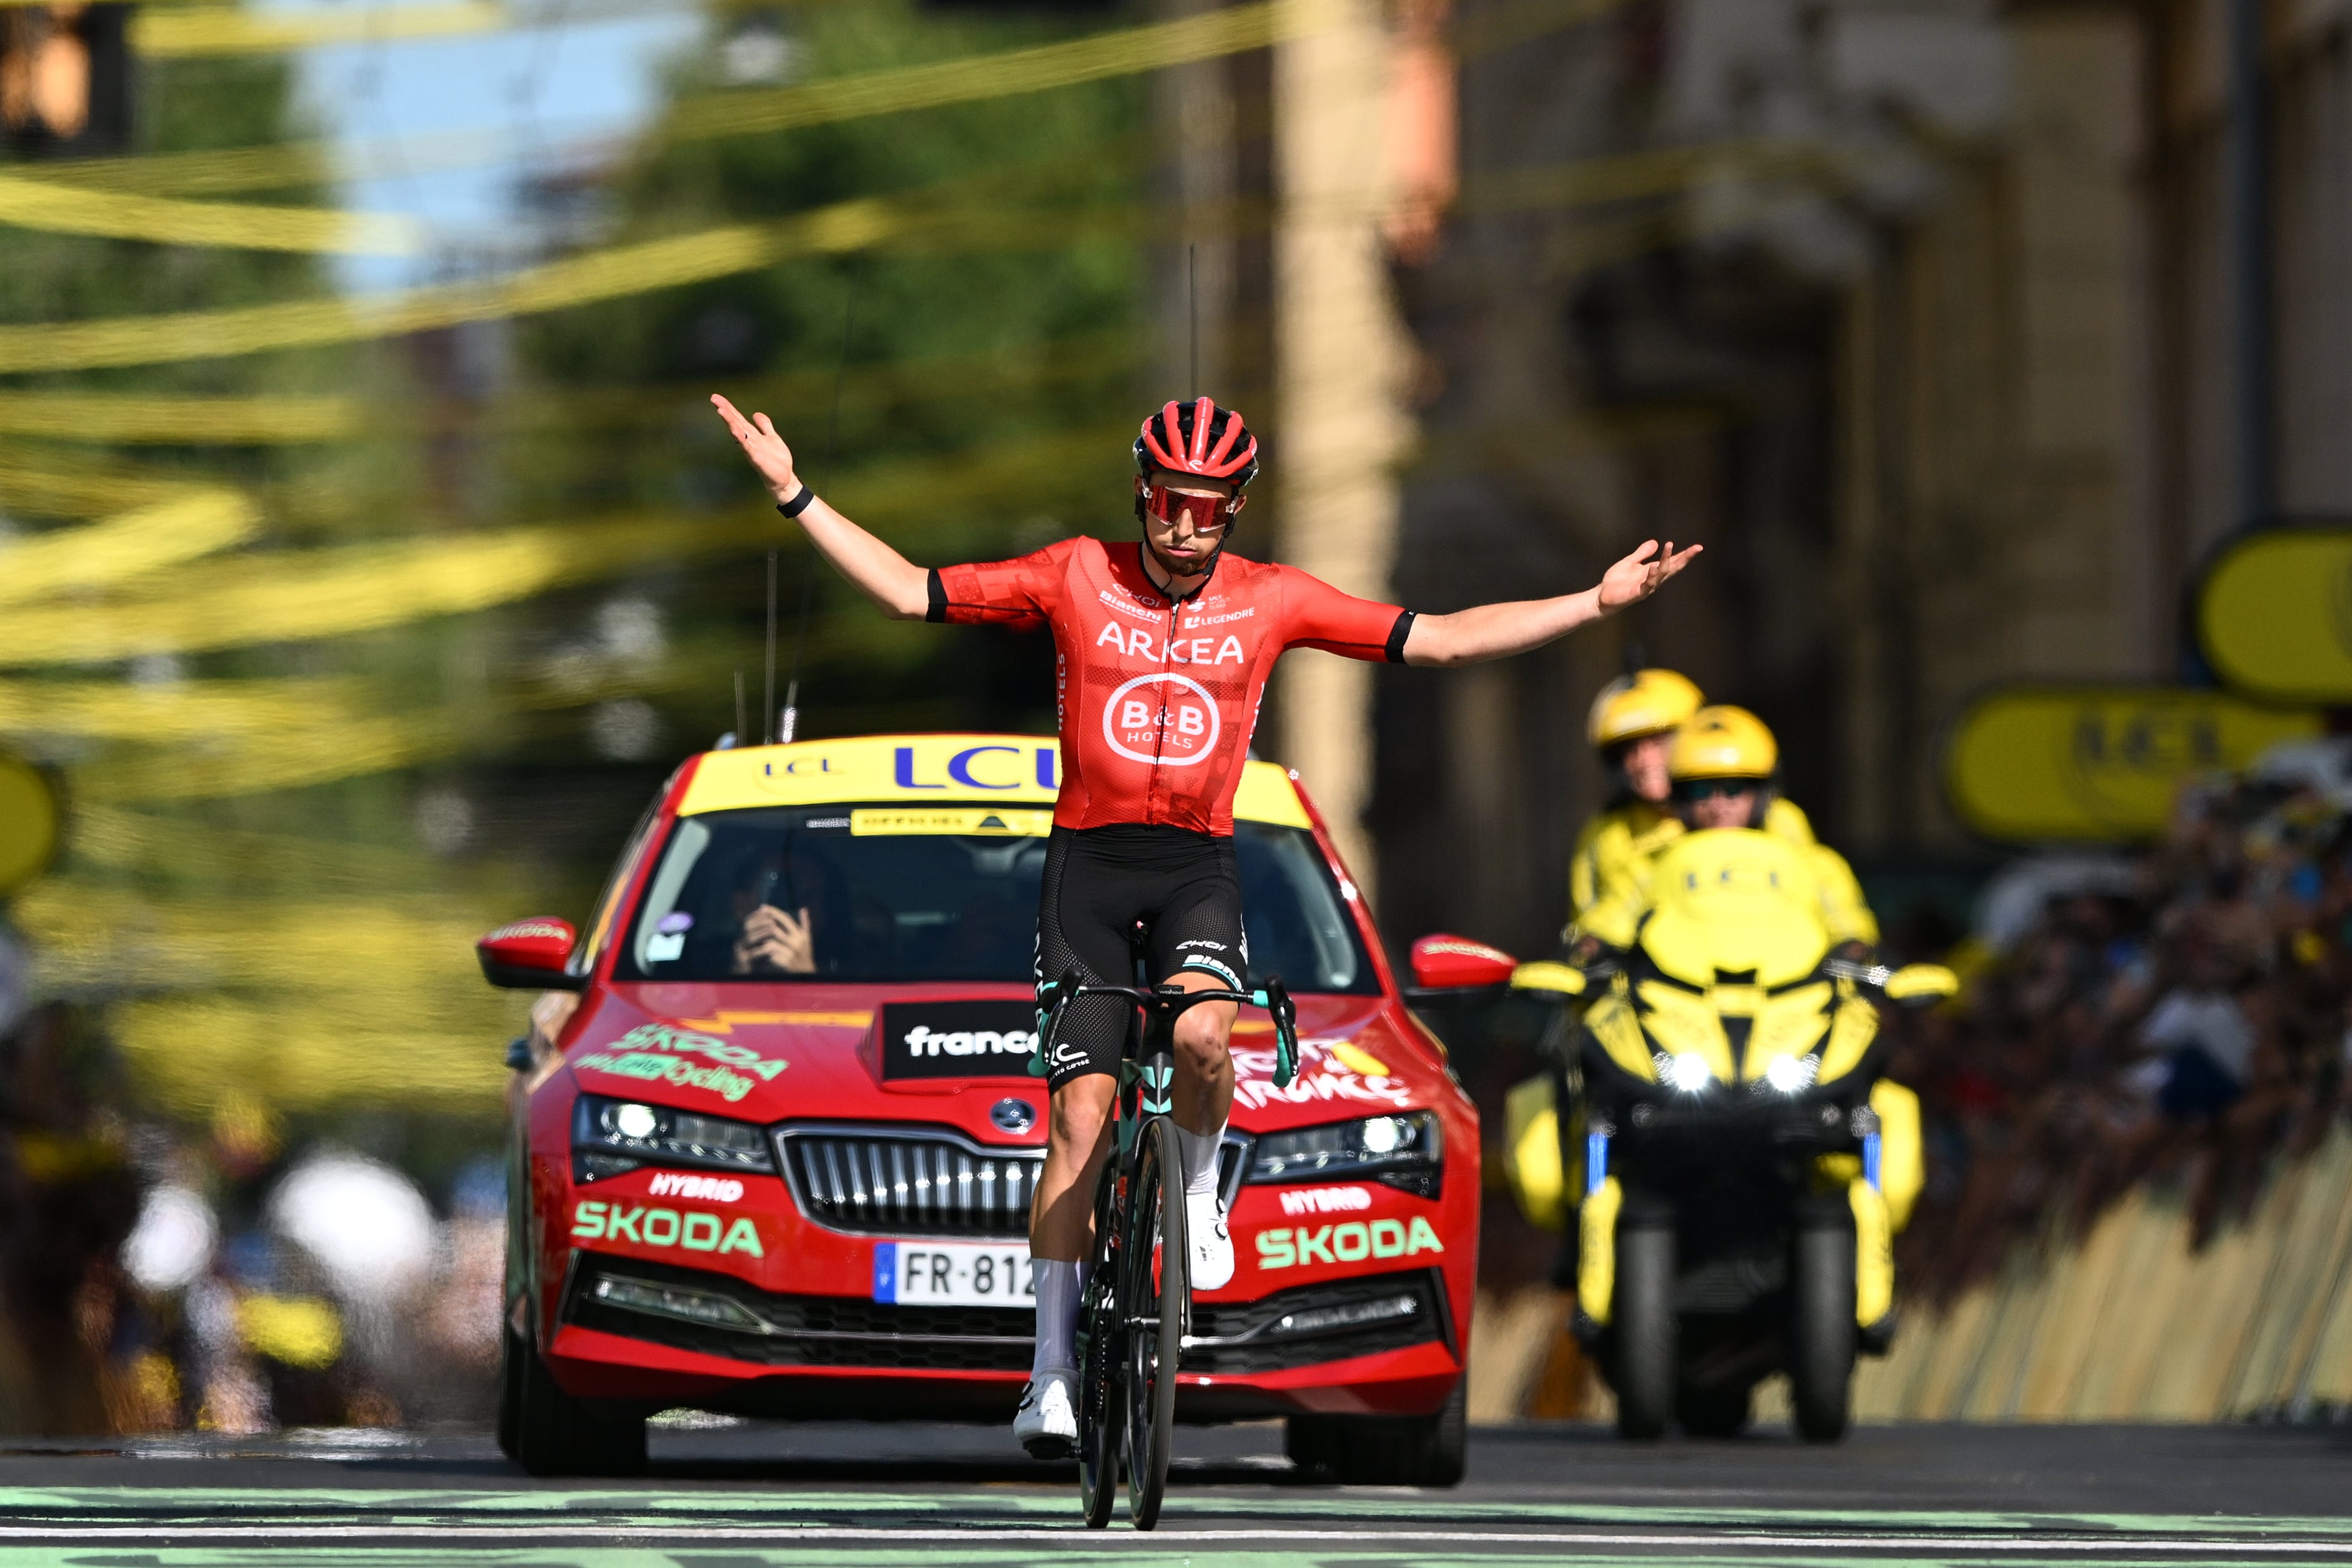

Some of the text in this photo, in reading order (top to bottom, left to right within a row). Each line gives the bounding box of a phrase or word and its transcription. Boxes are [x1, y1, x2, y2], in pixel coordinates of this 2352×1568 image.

[1099, 590, 1162, 622] Bianchi
[1201, 607, 1255, 626] LEGENDRE
[1096, 621, 1244, 665] ARKEA
[1058, 653, 1066, 731] HOTELS
[1126, 732, 1193, 750] HOTELS
[1184, 954, 1244, 992] Bianc
[649, 1172, 744, 1202] HYBRID
[1279, 1186, 1372, 1215] HYBRID
